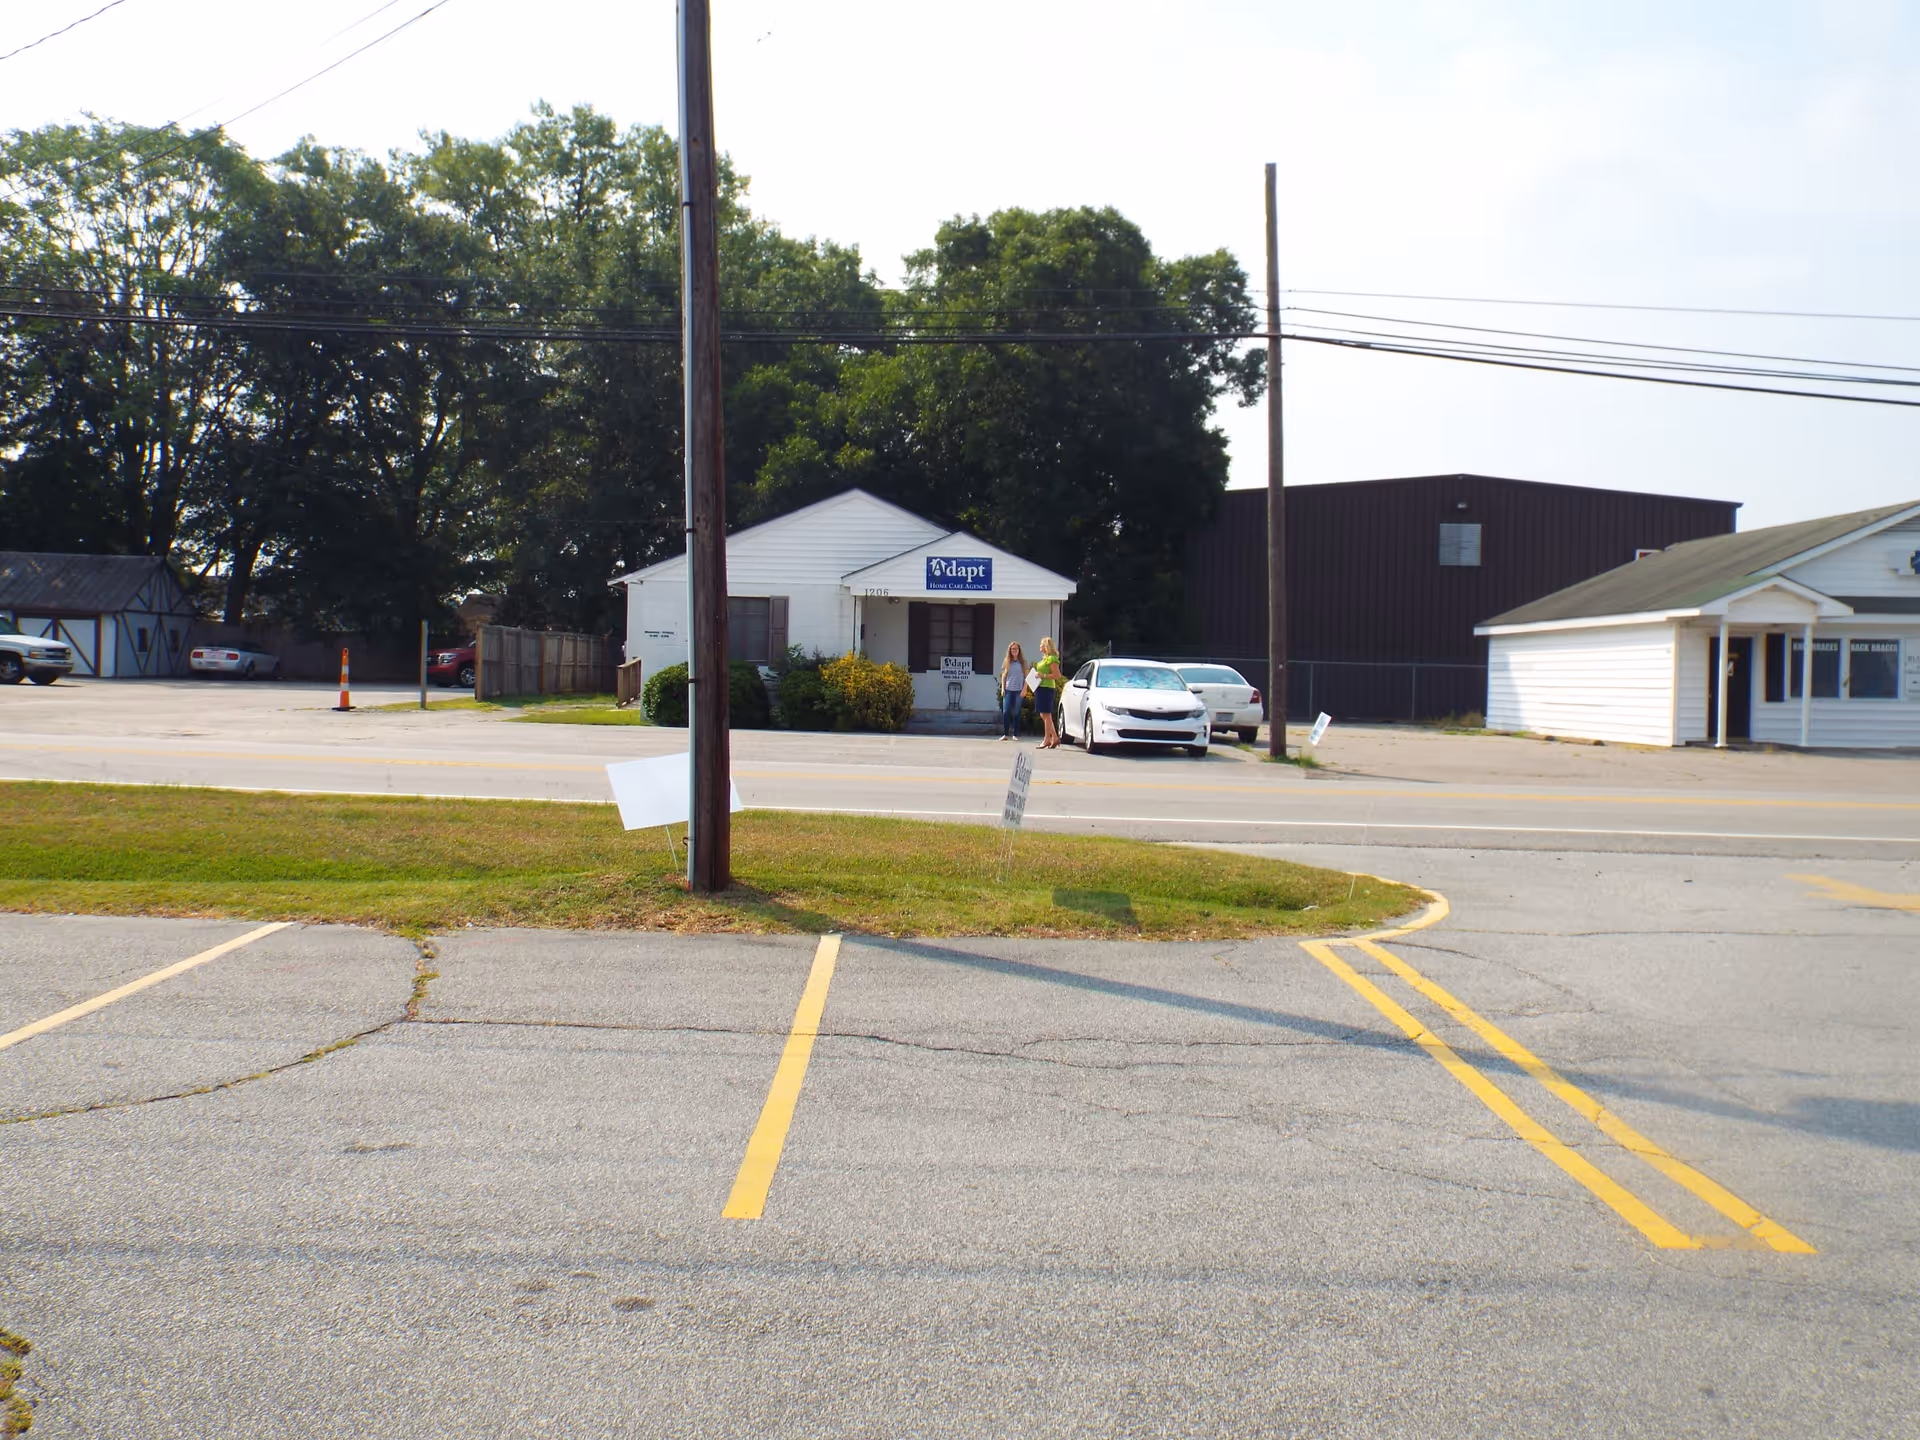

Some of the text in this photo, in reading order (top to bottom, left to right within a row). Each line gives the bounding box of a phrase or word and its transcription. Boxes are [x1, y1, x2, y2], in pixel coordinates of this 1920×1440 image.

[929, 558, 986, 583] Adapt
[865, 588, 889, 597] 1206
[944, 657, 971, 669] Adapt
